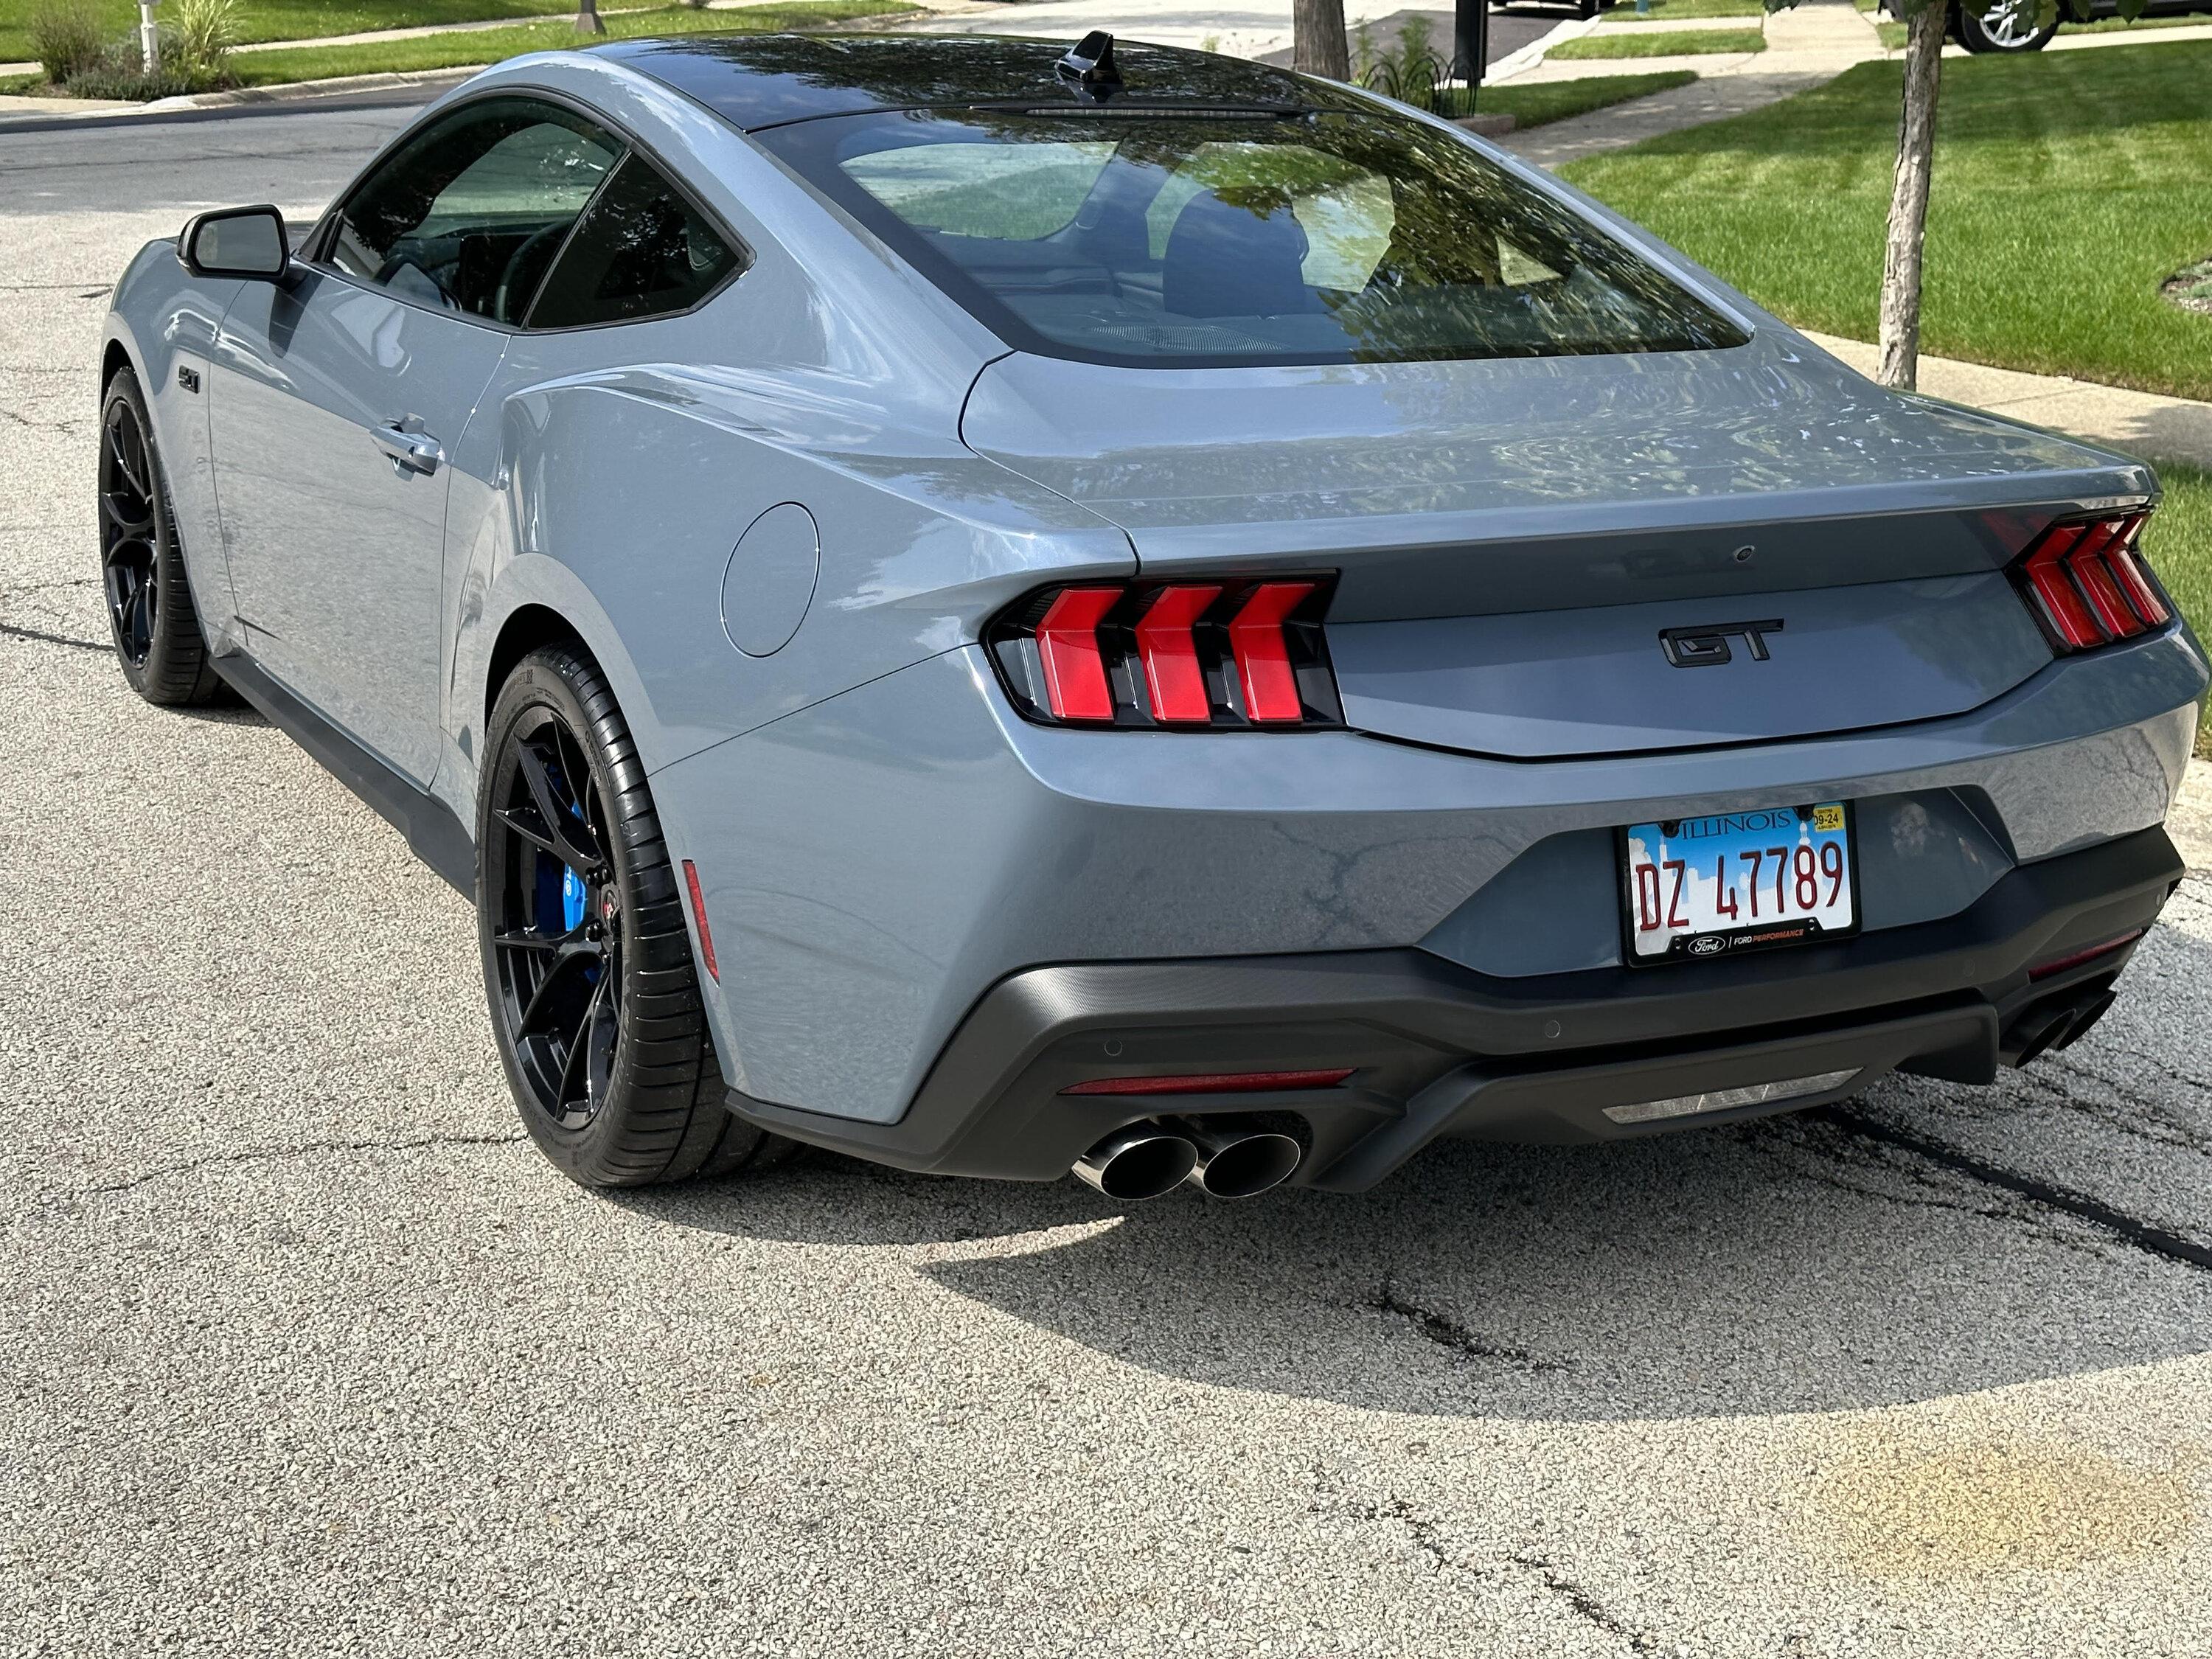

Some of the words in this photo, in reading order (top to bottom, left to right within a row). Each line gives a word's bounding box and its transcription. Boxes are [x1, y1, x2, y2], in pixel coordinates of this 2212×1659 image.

[1658, 618, 1784, 668] GT
[1682, 811, 1790, 840] ILLINOIS
[1635, 859, 1689, 931] DZ
[1717, 842, 1843, 920] 47789
[1695, 939, 1719, 952] Ford
[1734, 936, 1752, 945] FORD
[1753, 929, 1804, 943] PERFORMANCE
